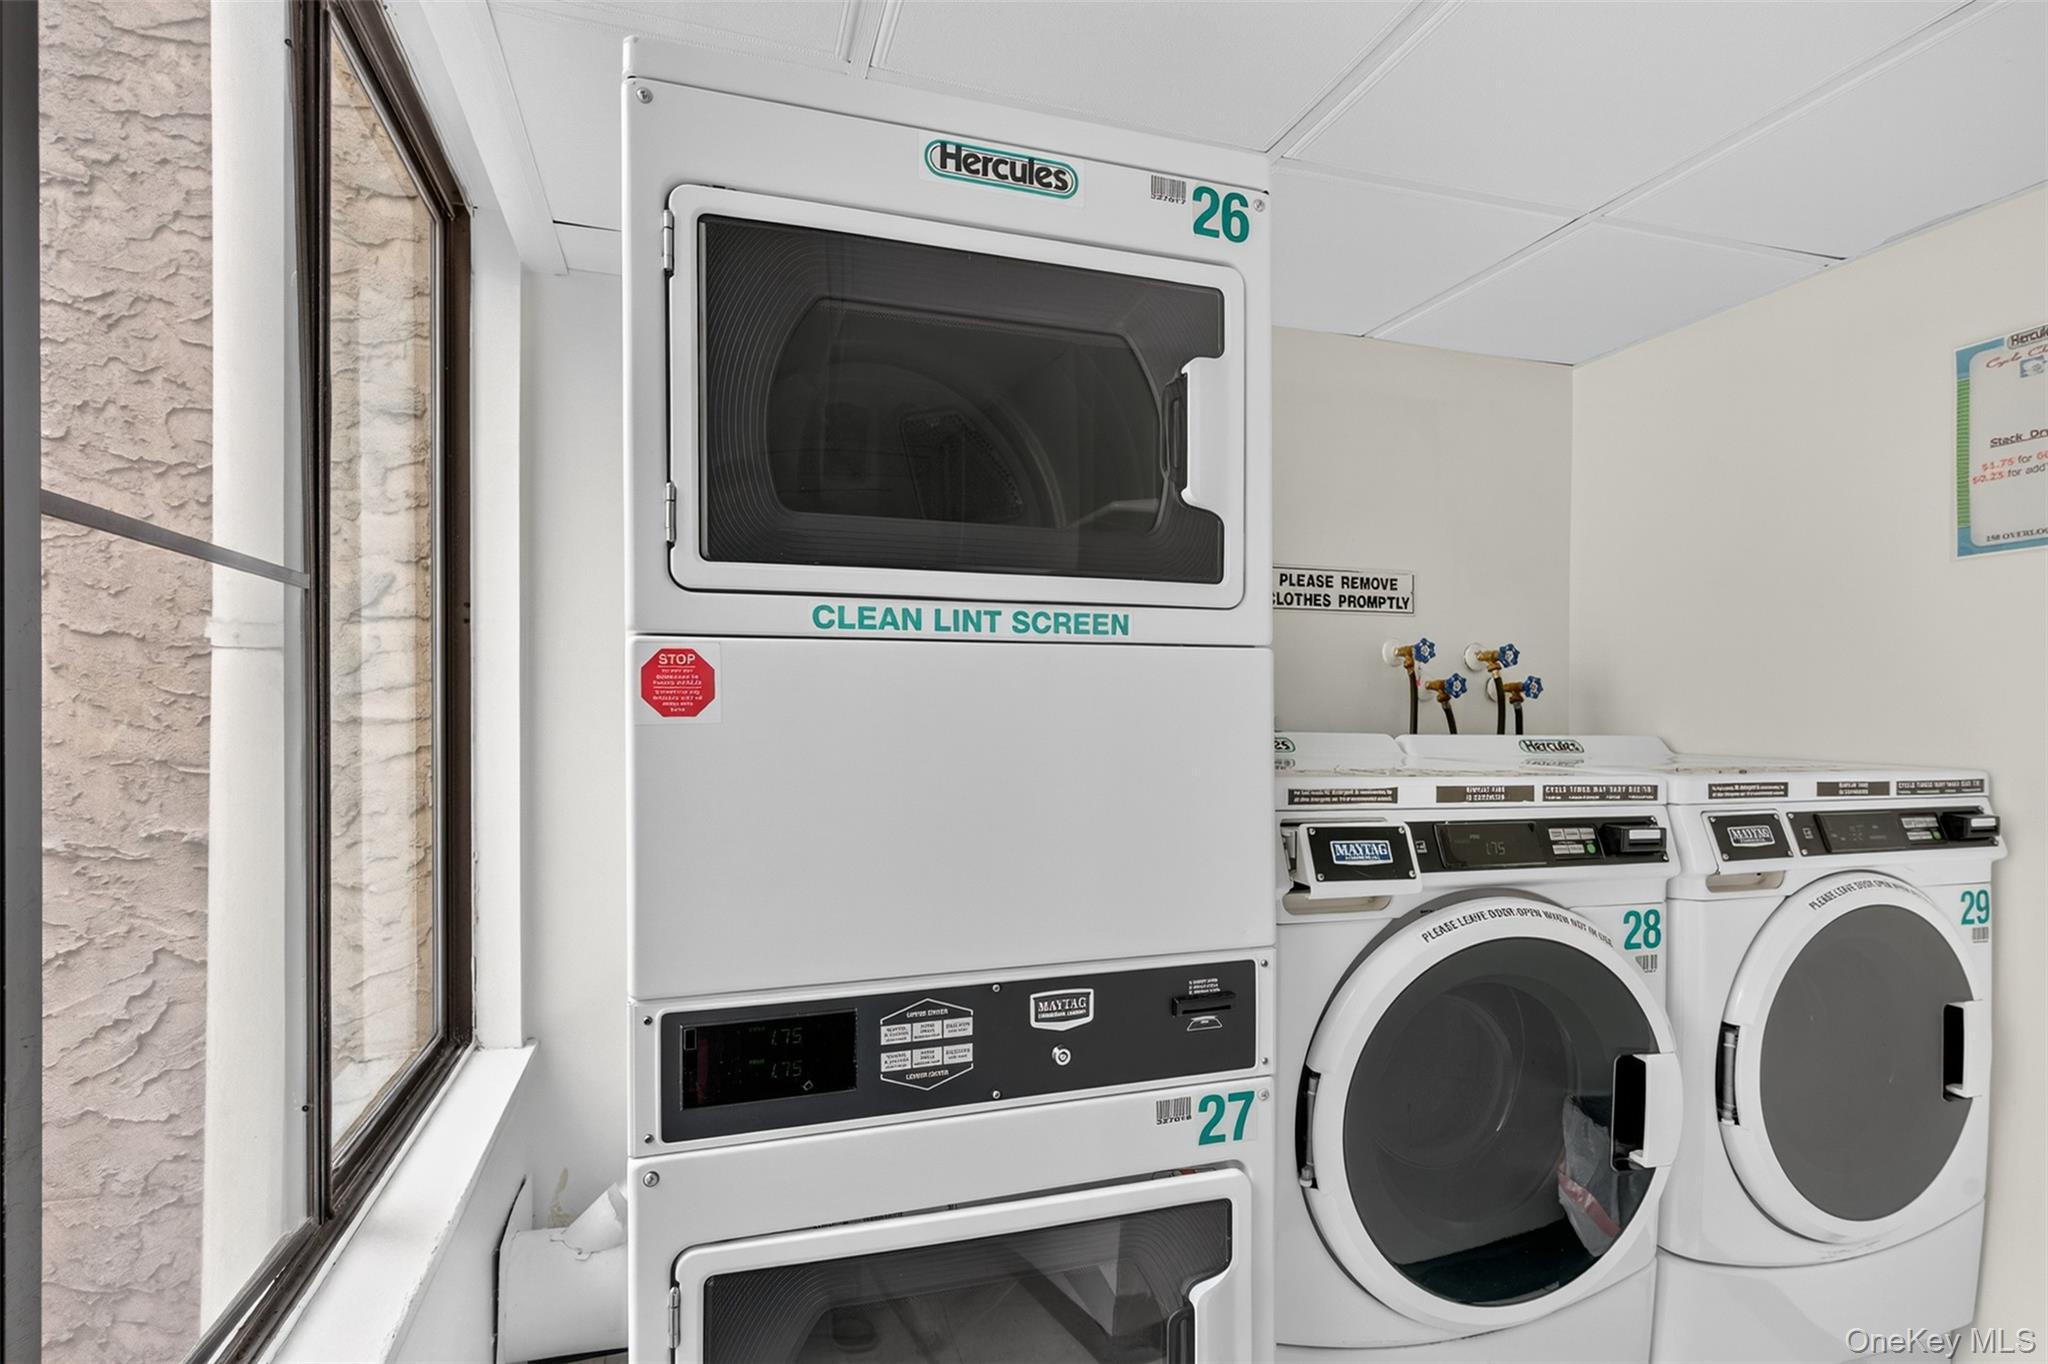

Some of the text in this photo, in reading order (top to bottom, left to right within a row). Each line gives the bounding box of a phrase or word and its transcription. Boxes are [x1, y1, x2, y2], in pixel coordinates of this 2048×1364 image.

[939, 142, 1069, 192] Hercules
[1192, 186, 1250, 243] 26
[2011, 324, 2048, 346] Hercul
[1990, 433, 2023, 448] Stack
[2018, 455, 2032, 464] for
[2008, 467, 2022, 478] for
[1279, 573, 1398, 591] PLEASE REMOVE
[1338, 595, 1410, 610] PROMPTLY
[812, 605, 1130, 636] CLEAN LINT SCREEN
[658, 653, 696, 665] STOP
[1334, 842, 1389, 858] MAYTAG
[1960, 889, 1990, 926] 29
[1623, 909, 1662, 950] 28
[1038, 996, 1087, 1012] MAYTAG
[1198, 1090, 1256, 1146] 27
